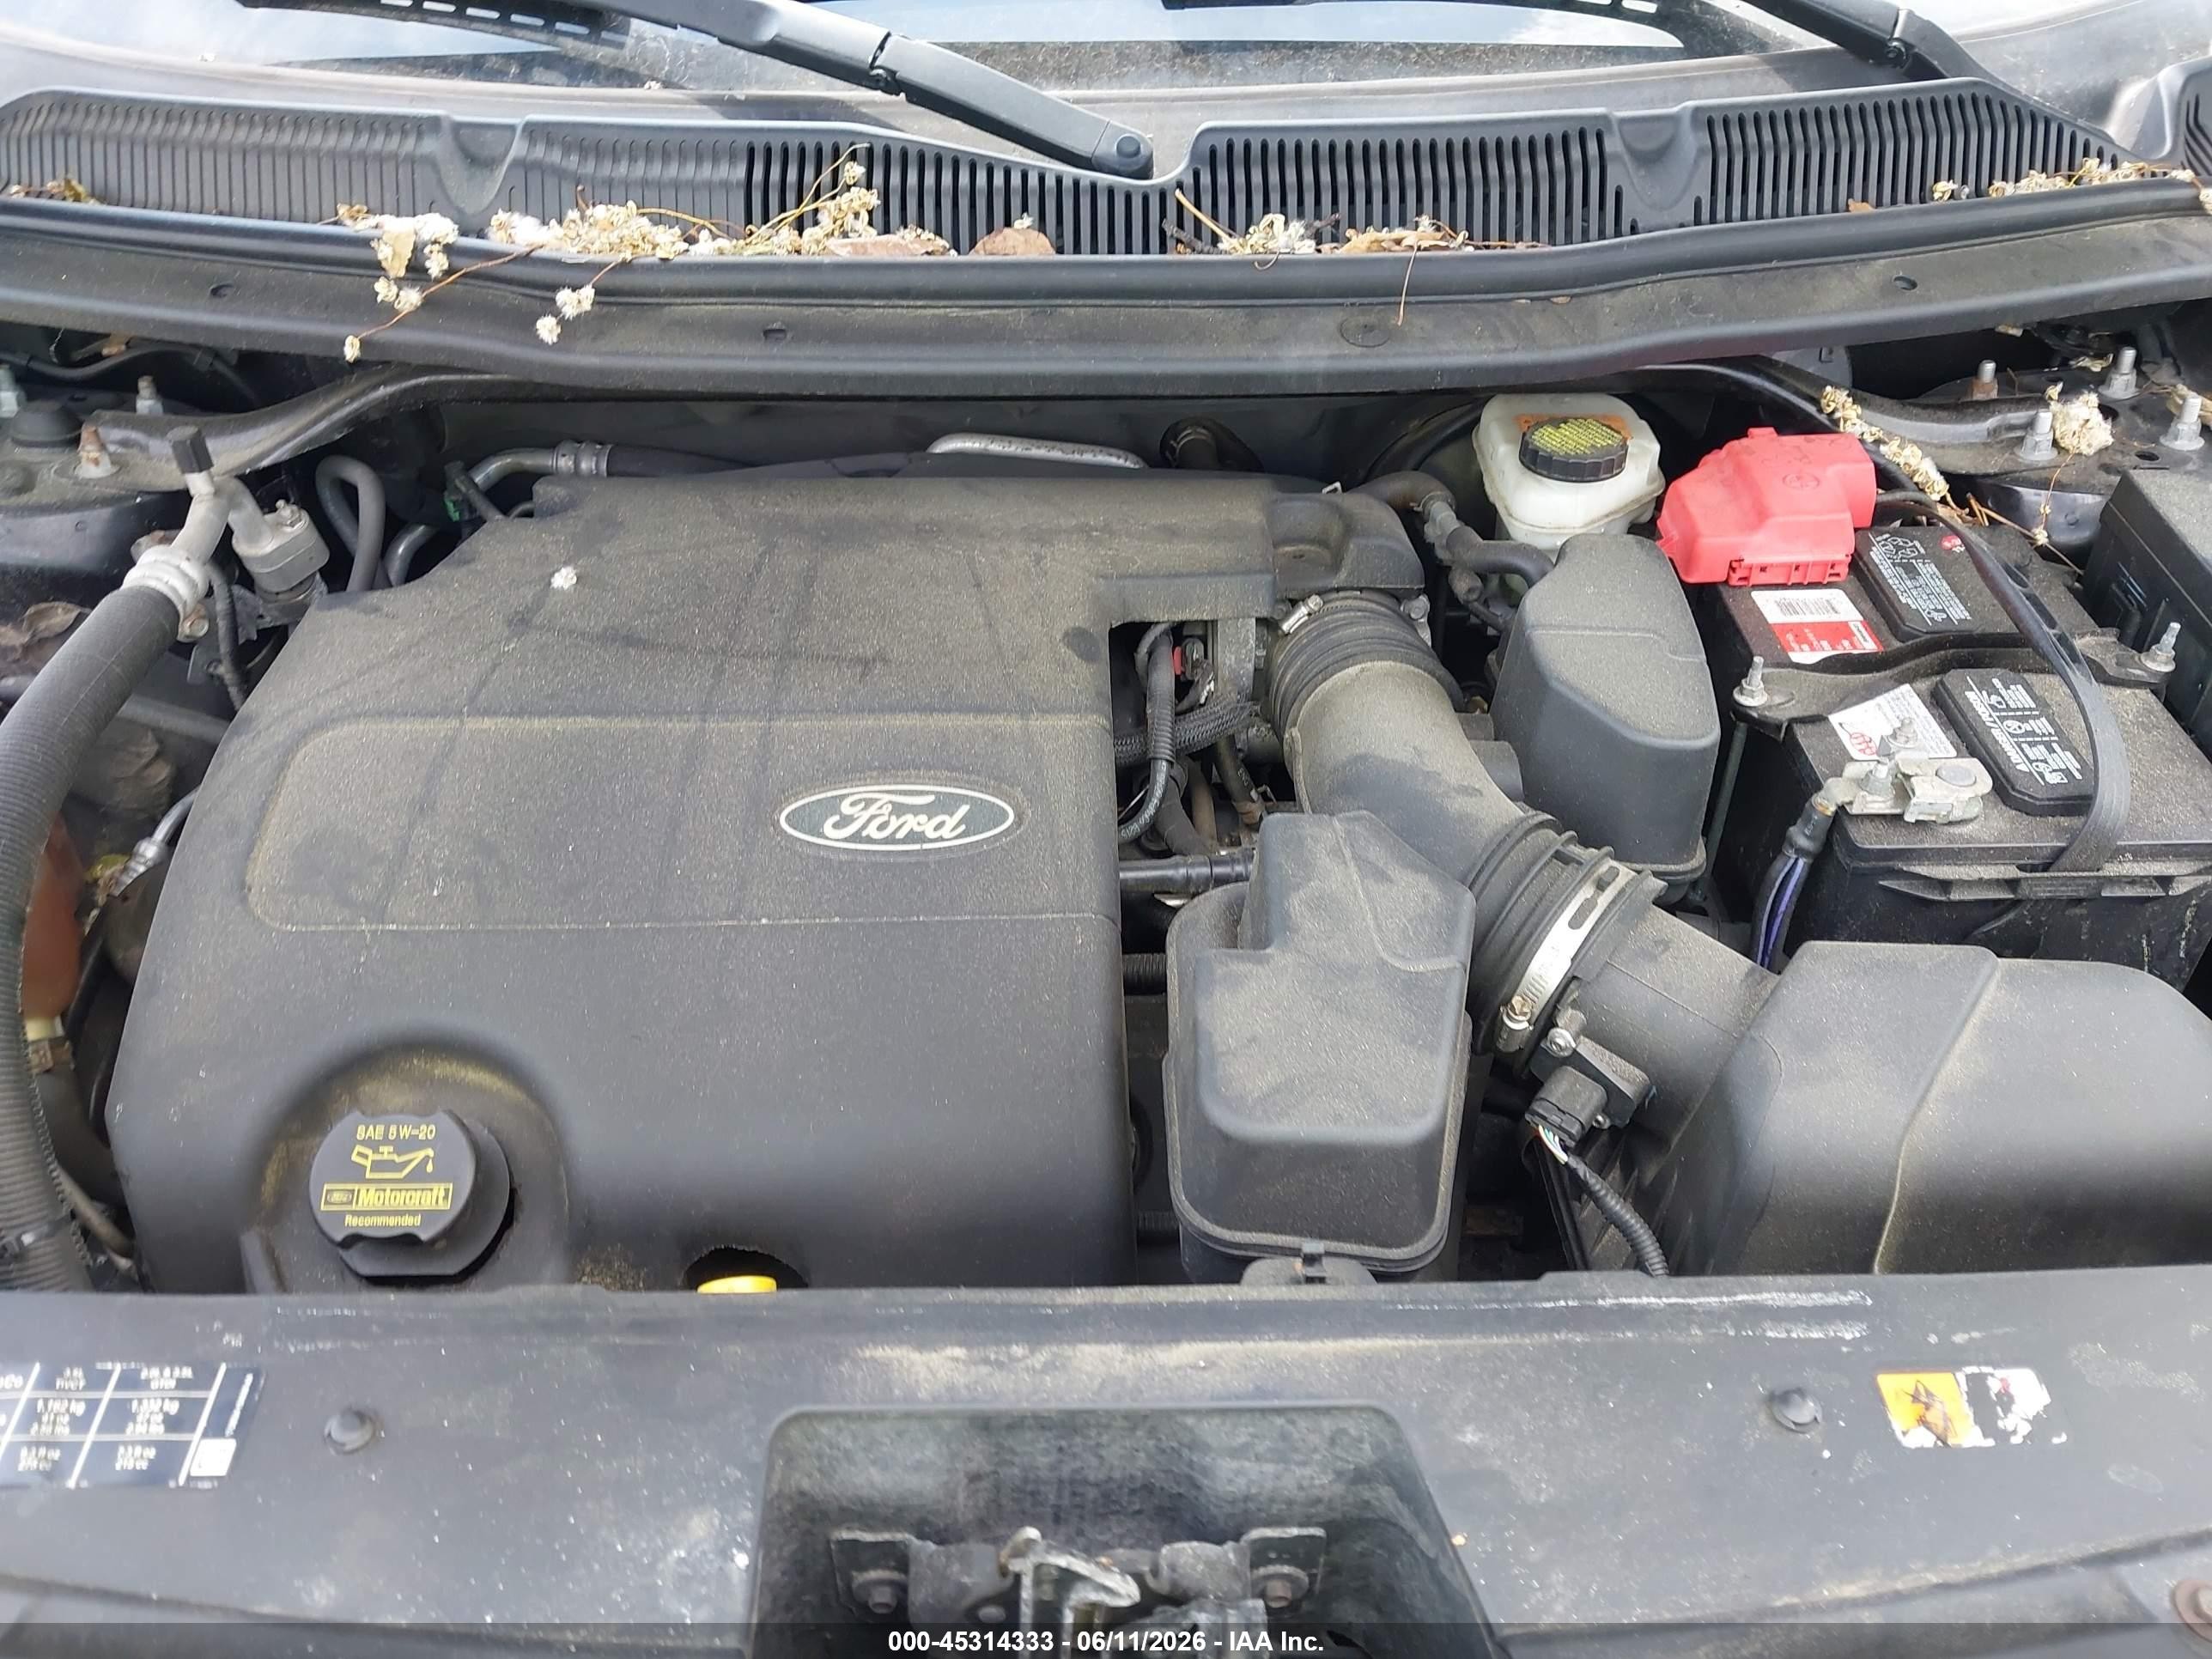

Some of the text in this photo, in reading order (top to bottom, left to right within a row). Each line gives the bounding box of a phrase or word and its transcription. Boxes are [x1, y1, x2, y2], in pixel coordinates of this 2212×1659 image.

[823, 792, 970, 840] Ford
[356, 1124, 385, 1140] SAE
[358, 1187, 446, 1206] Motorcraft
[344, 1213, 422, 1227] Recommended
